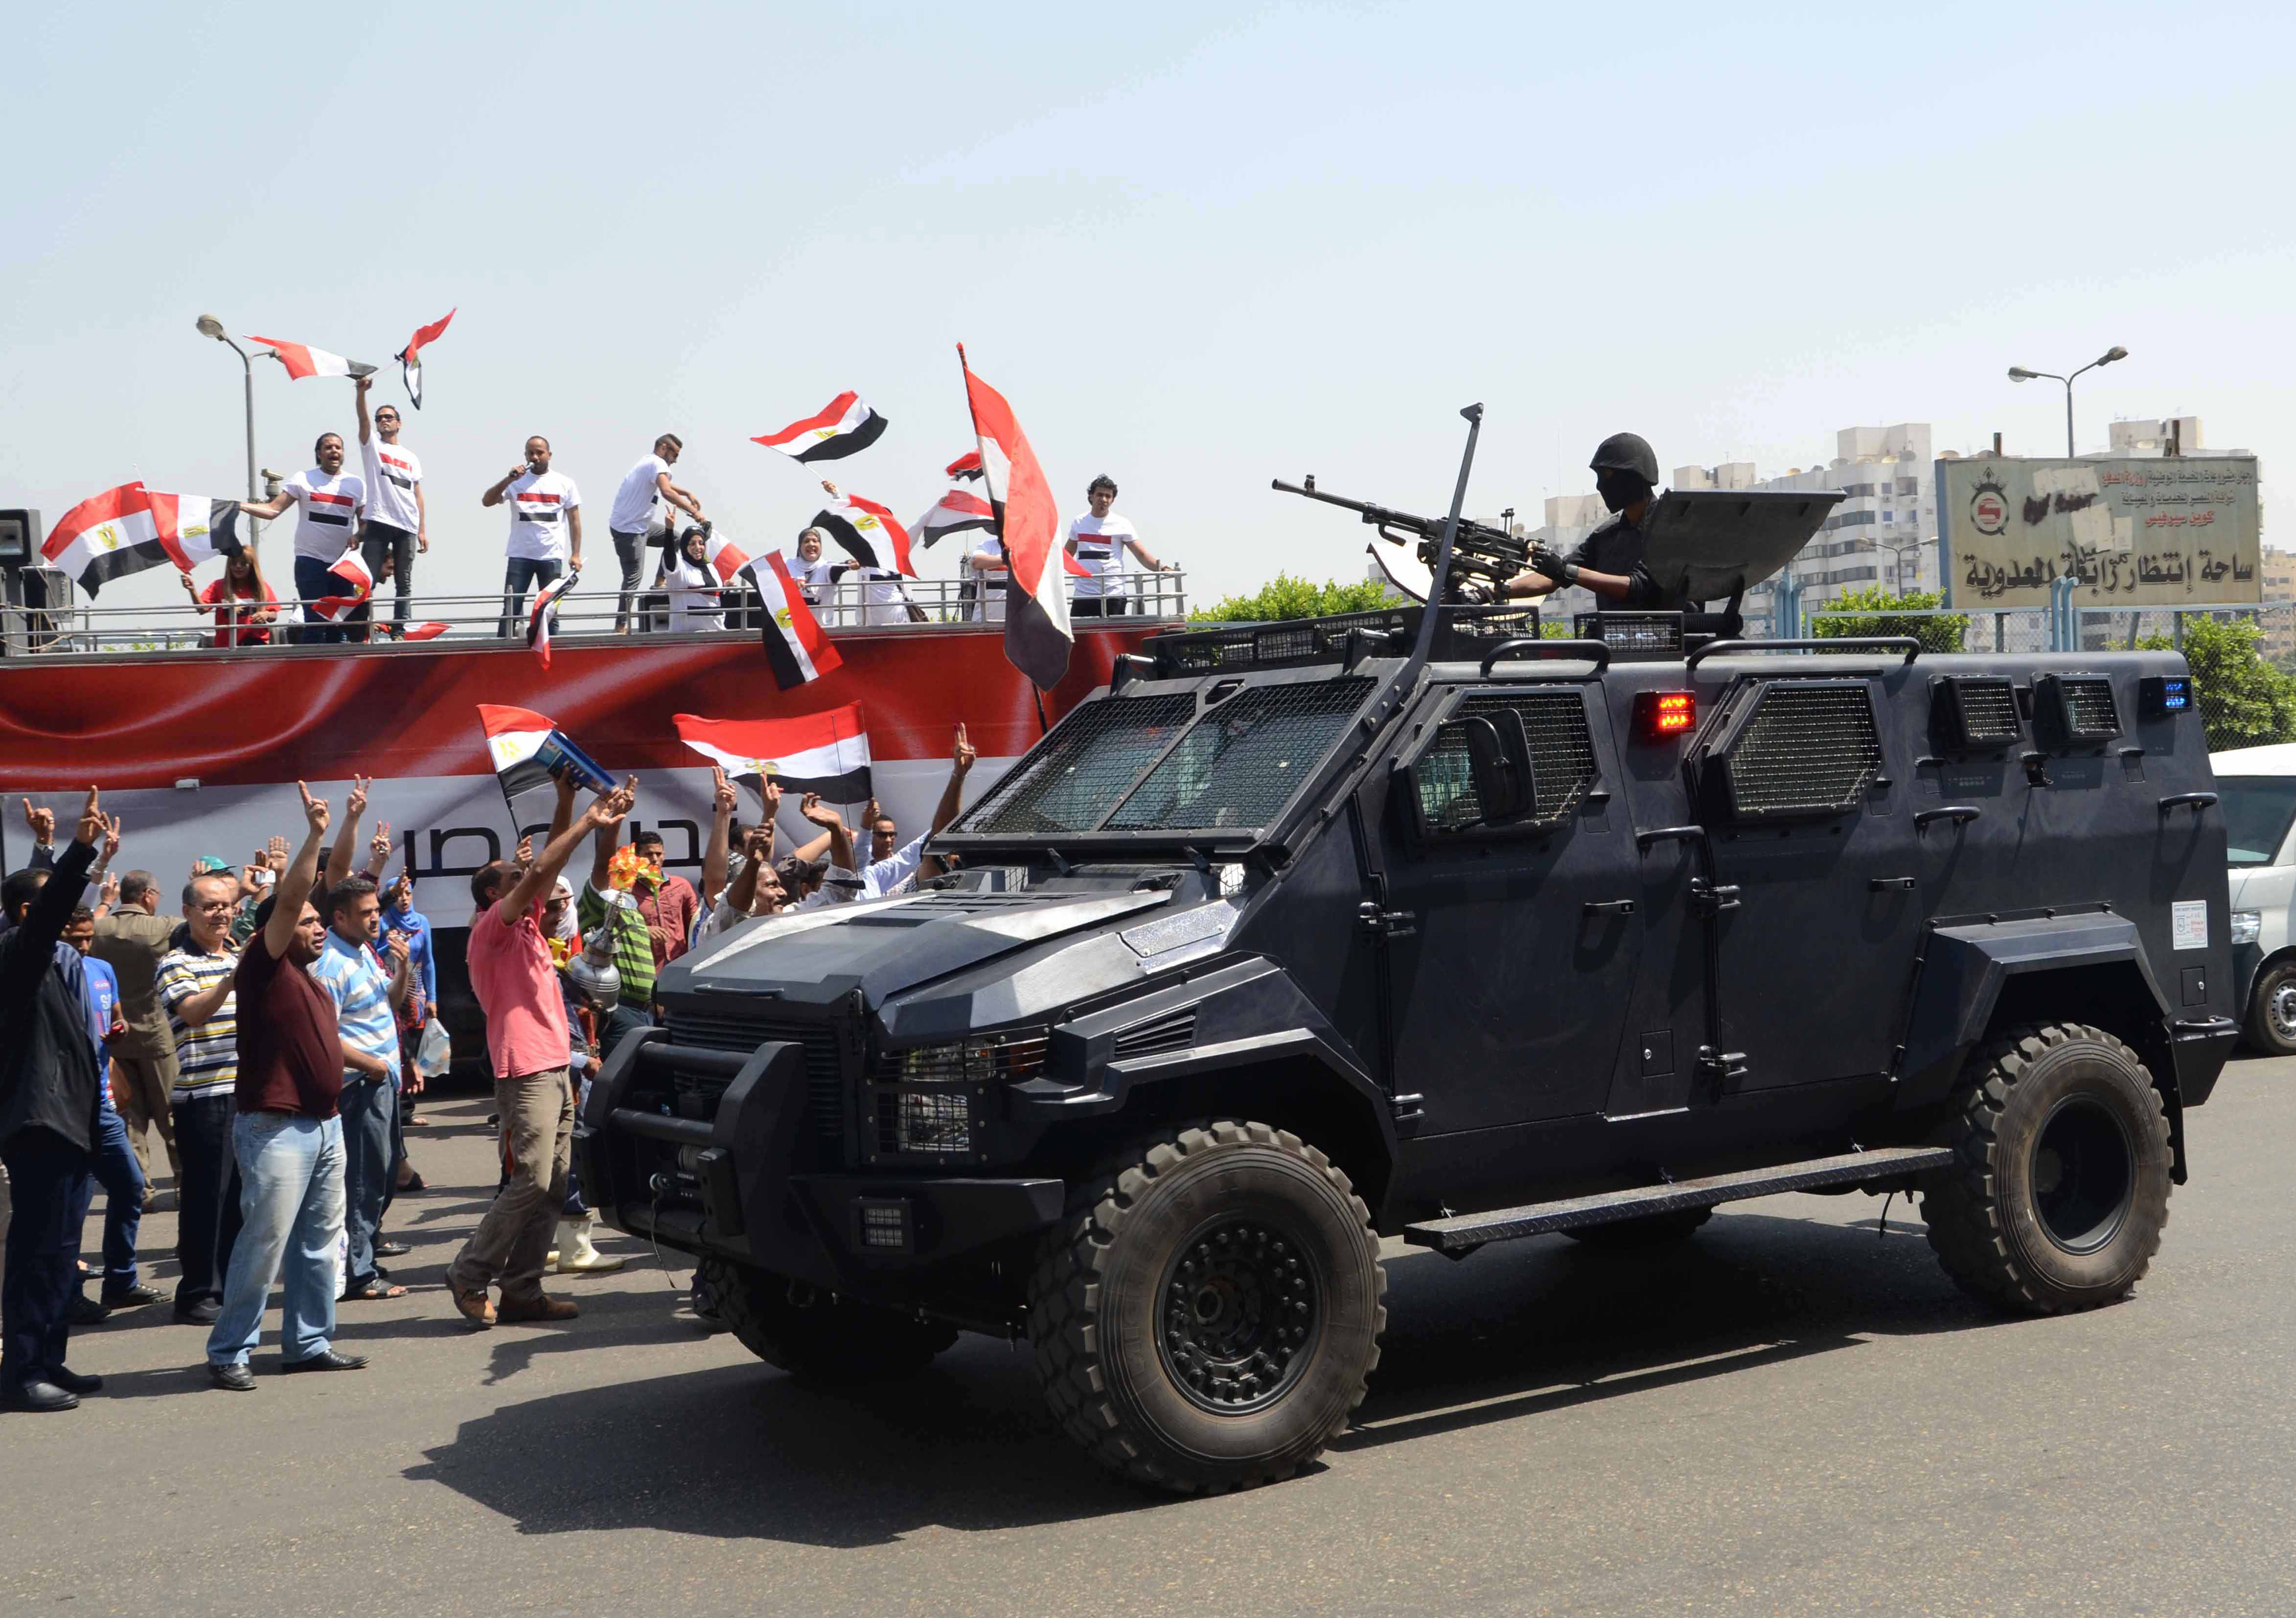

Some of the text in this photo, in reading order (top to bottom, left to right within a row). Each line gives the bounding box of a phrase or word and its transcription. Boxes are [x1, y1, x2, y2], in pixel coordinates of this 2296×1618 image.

[2145, 510, 2214, 527] كوين سيرفيس
[2199, 549, 2255, 582] ساحة
